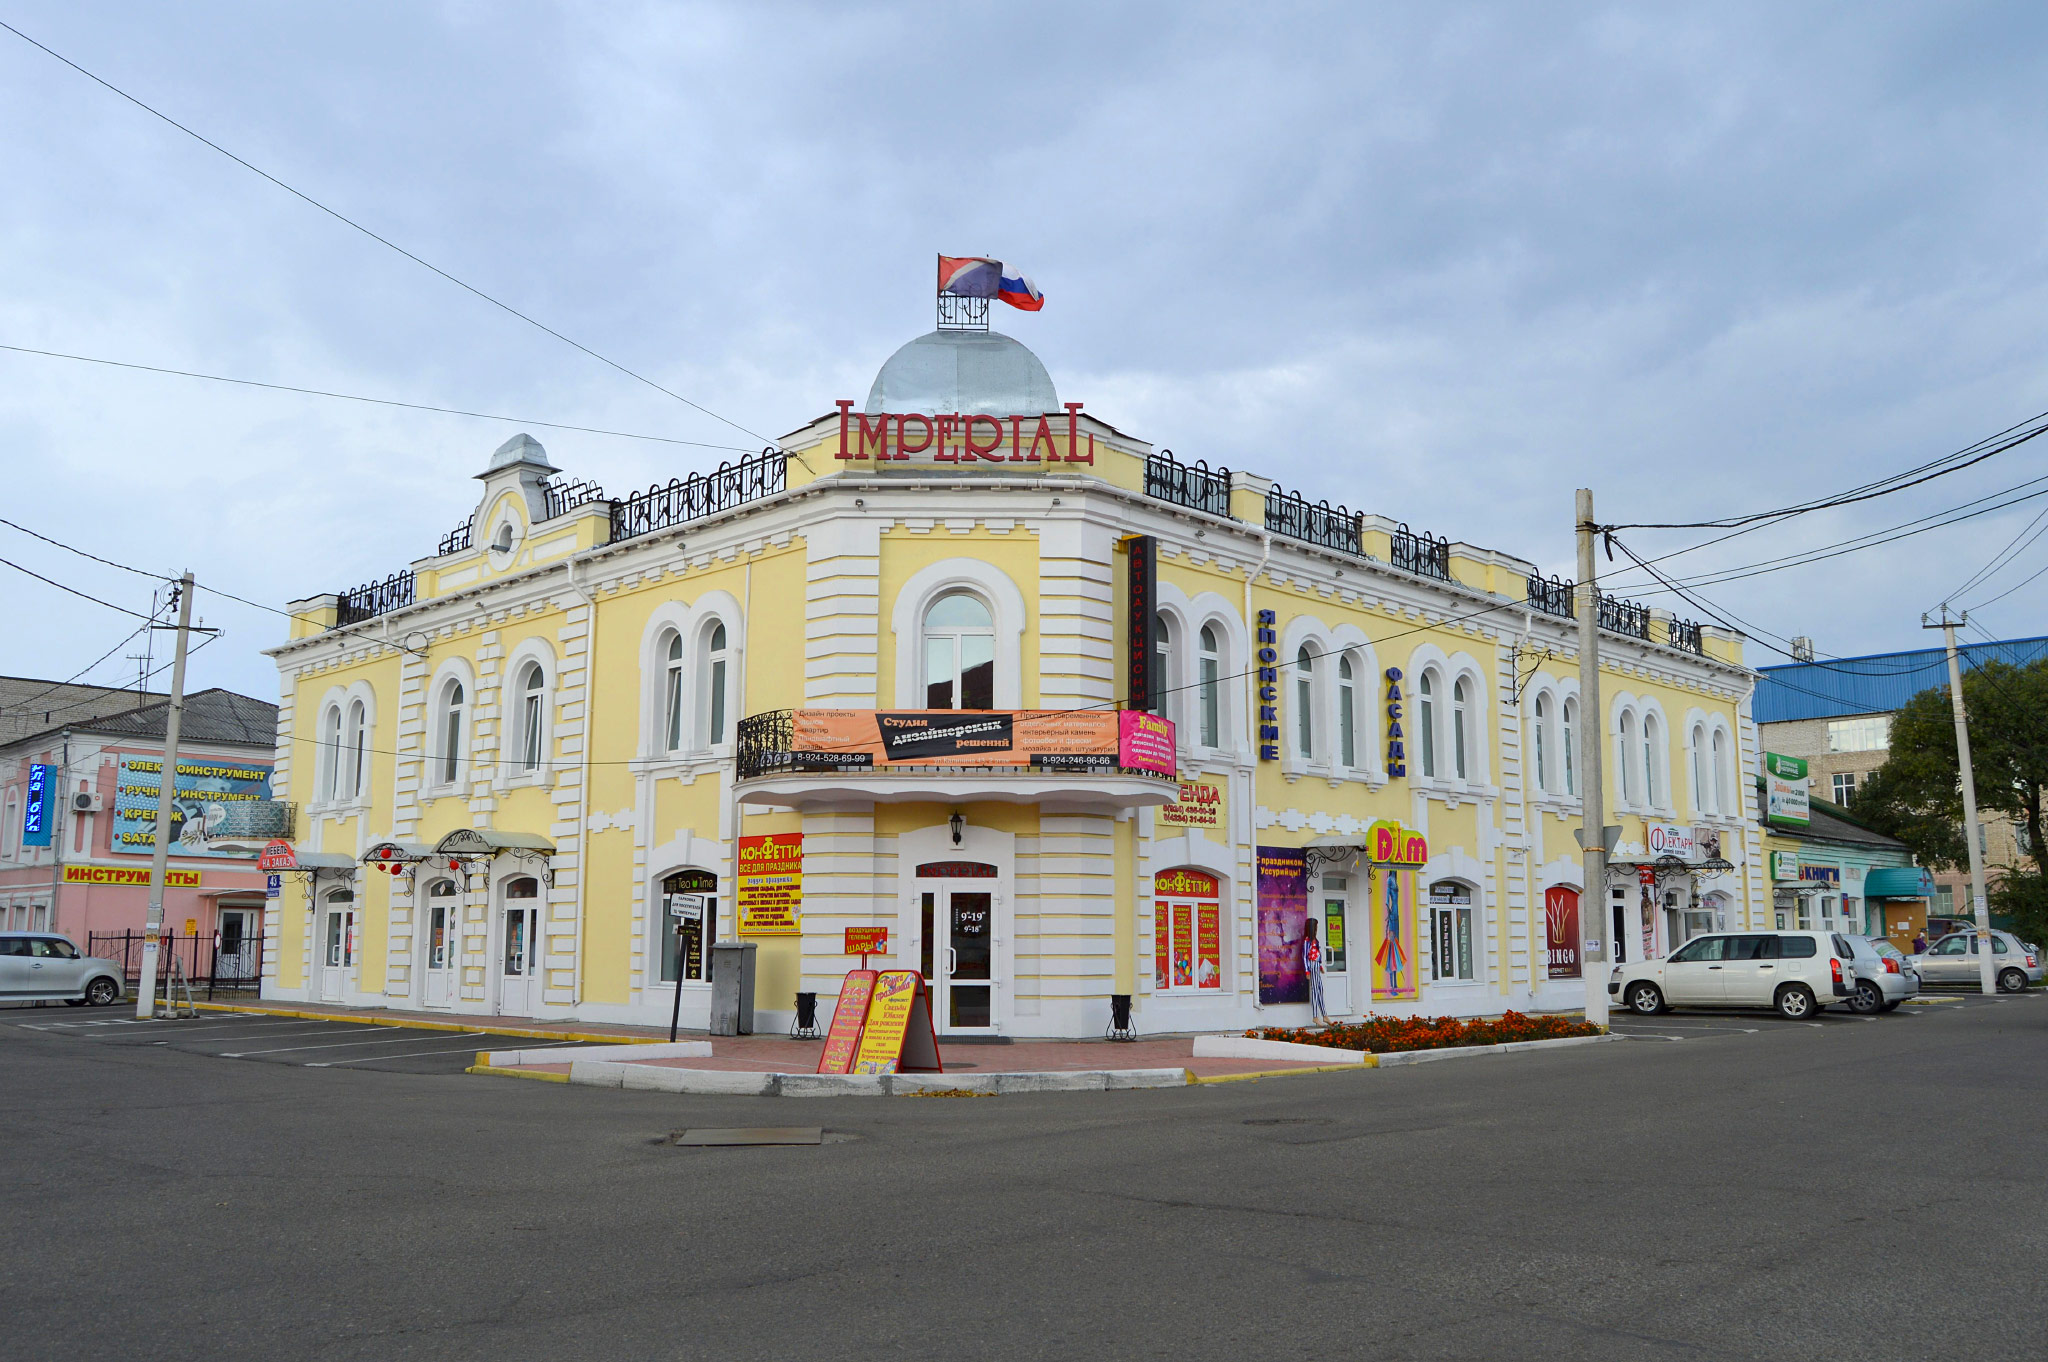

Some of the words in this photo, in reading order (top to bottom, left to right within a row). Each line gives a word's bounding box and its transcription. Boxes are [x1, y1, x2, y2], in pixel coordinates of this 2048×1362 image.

[834, 400, 1094, 466] IMPERIAL
[1258, 608, 1279, 761] ЯПОНСКИЕ
[799, 710, 824, 718] Дизайн
[826, 711, 856, 719] проекты
[883, 717, 928, 728] Студия
[1139, 716, 1168, 737] Family
[1386, 667, 1406, 778] ФАСАДЫ
[892, 720, 1003, 746] дизайнерских
[956, 738, 1010, 749] решений
[797, 753, 866, 763] 8-924-528-69-99
[1042, 756, 1110, 765] 8-924-246-96-66
[128, 760, 266, 780] ЭЛЕКОИНСТРУМЕНТ
[1180, 784, 1221, 807] ЕНДА
[124, 809, 183, 822] КРЕПЖ
[122, 833, 156, 843] SATA
[740, 837, 801, 860] КОНФЕТТИ
[262, 858, 270, 868] НА
[272, 857, 291, 867] ЗАКАЗ
[740, 864, 751, 873] ВСЕ
[752, 863, 764, 873] ДЛЯ
[766, 861, 802, 872] ПРАЗДНИКА
[1261, 857, 1306, 867] праздником,
[67, 868, 199, 885] ИНСТРУМНТЫ
[1260, 867, 1301, 877] Уссурийцы!
[1804, 866, 1840, 882] КНИГИ
[1155, 871, 1211, 893] КОНФЕТТИ
[846, 941, 874, 953] ШАРЫ
[1547, 949, 1574, 964] BINGO
